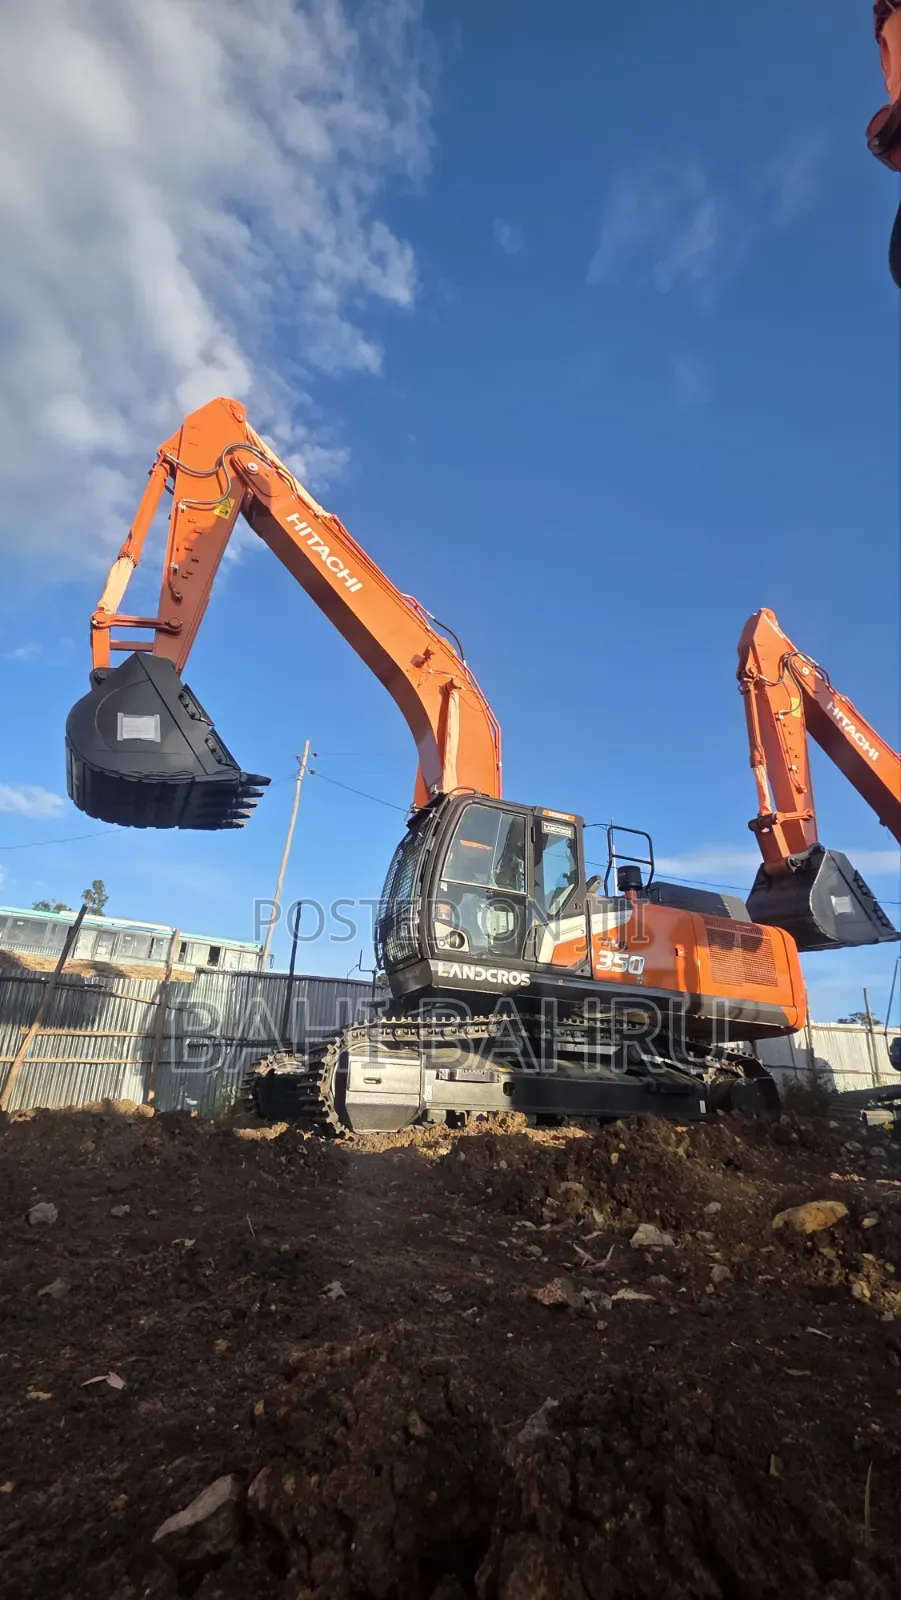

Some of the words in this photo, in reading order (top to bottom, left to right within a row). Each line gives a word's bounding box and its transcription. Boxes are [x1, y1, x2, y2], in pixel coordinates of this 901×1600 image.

[286, 512, 363, 593] HITACHI
[826, 701, 880, 762] HITACHI
[437, 961, 531, 987] LANDCROS
[595, 949, 646, 975] 350
